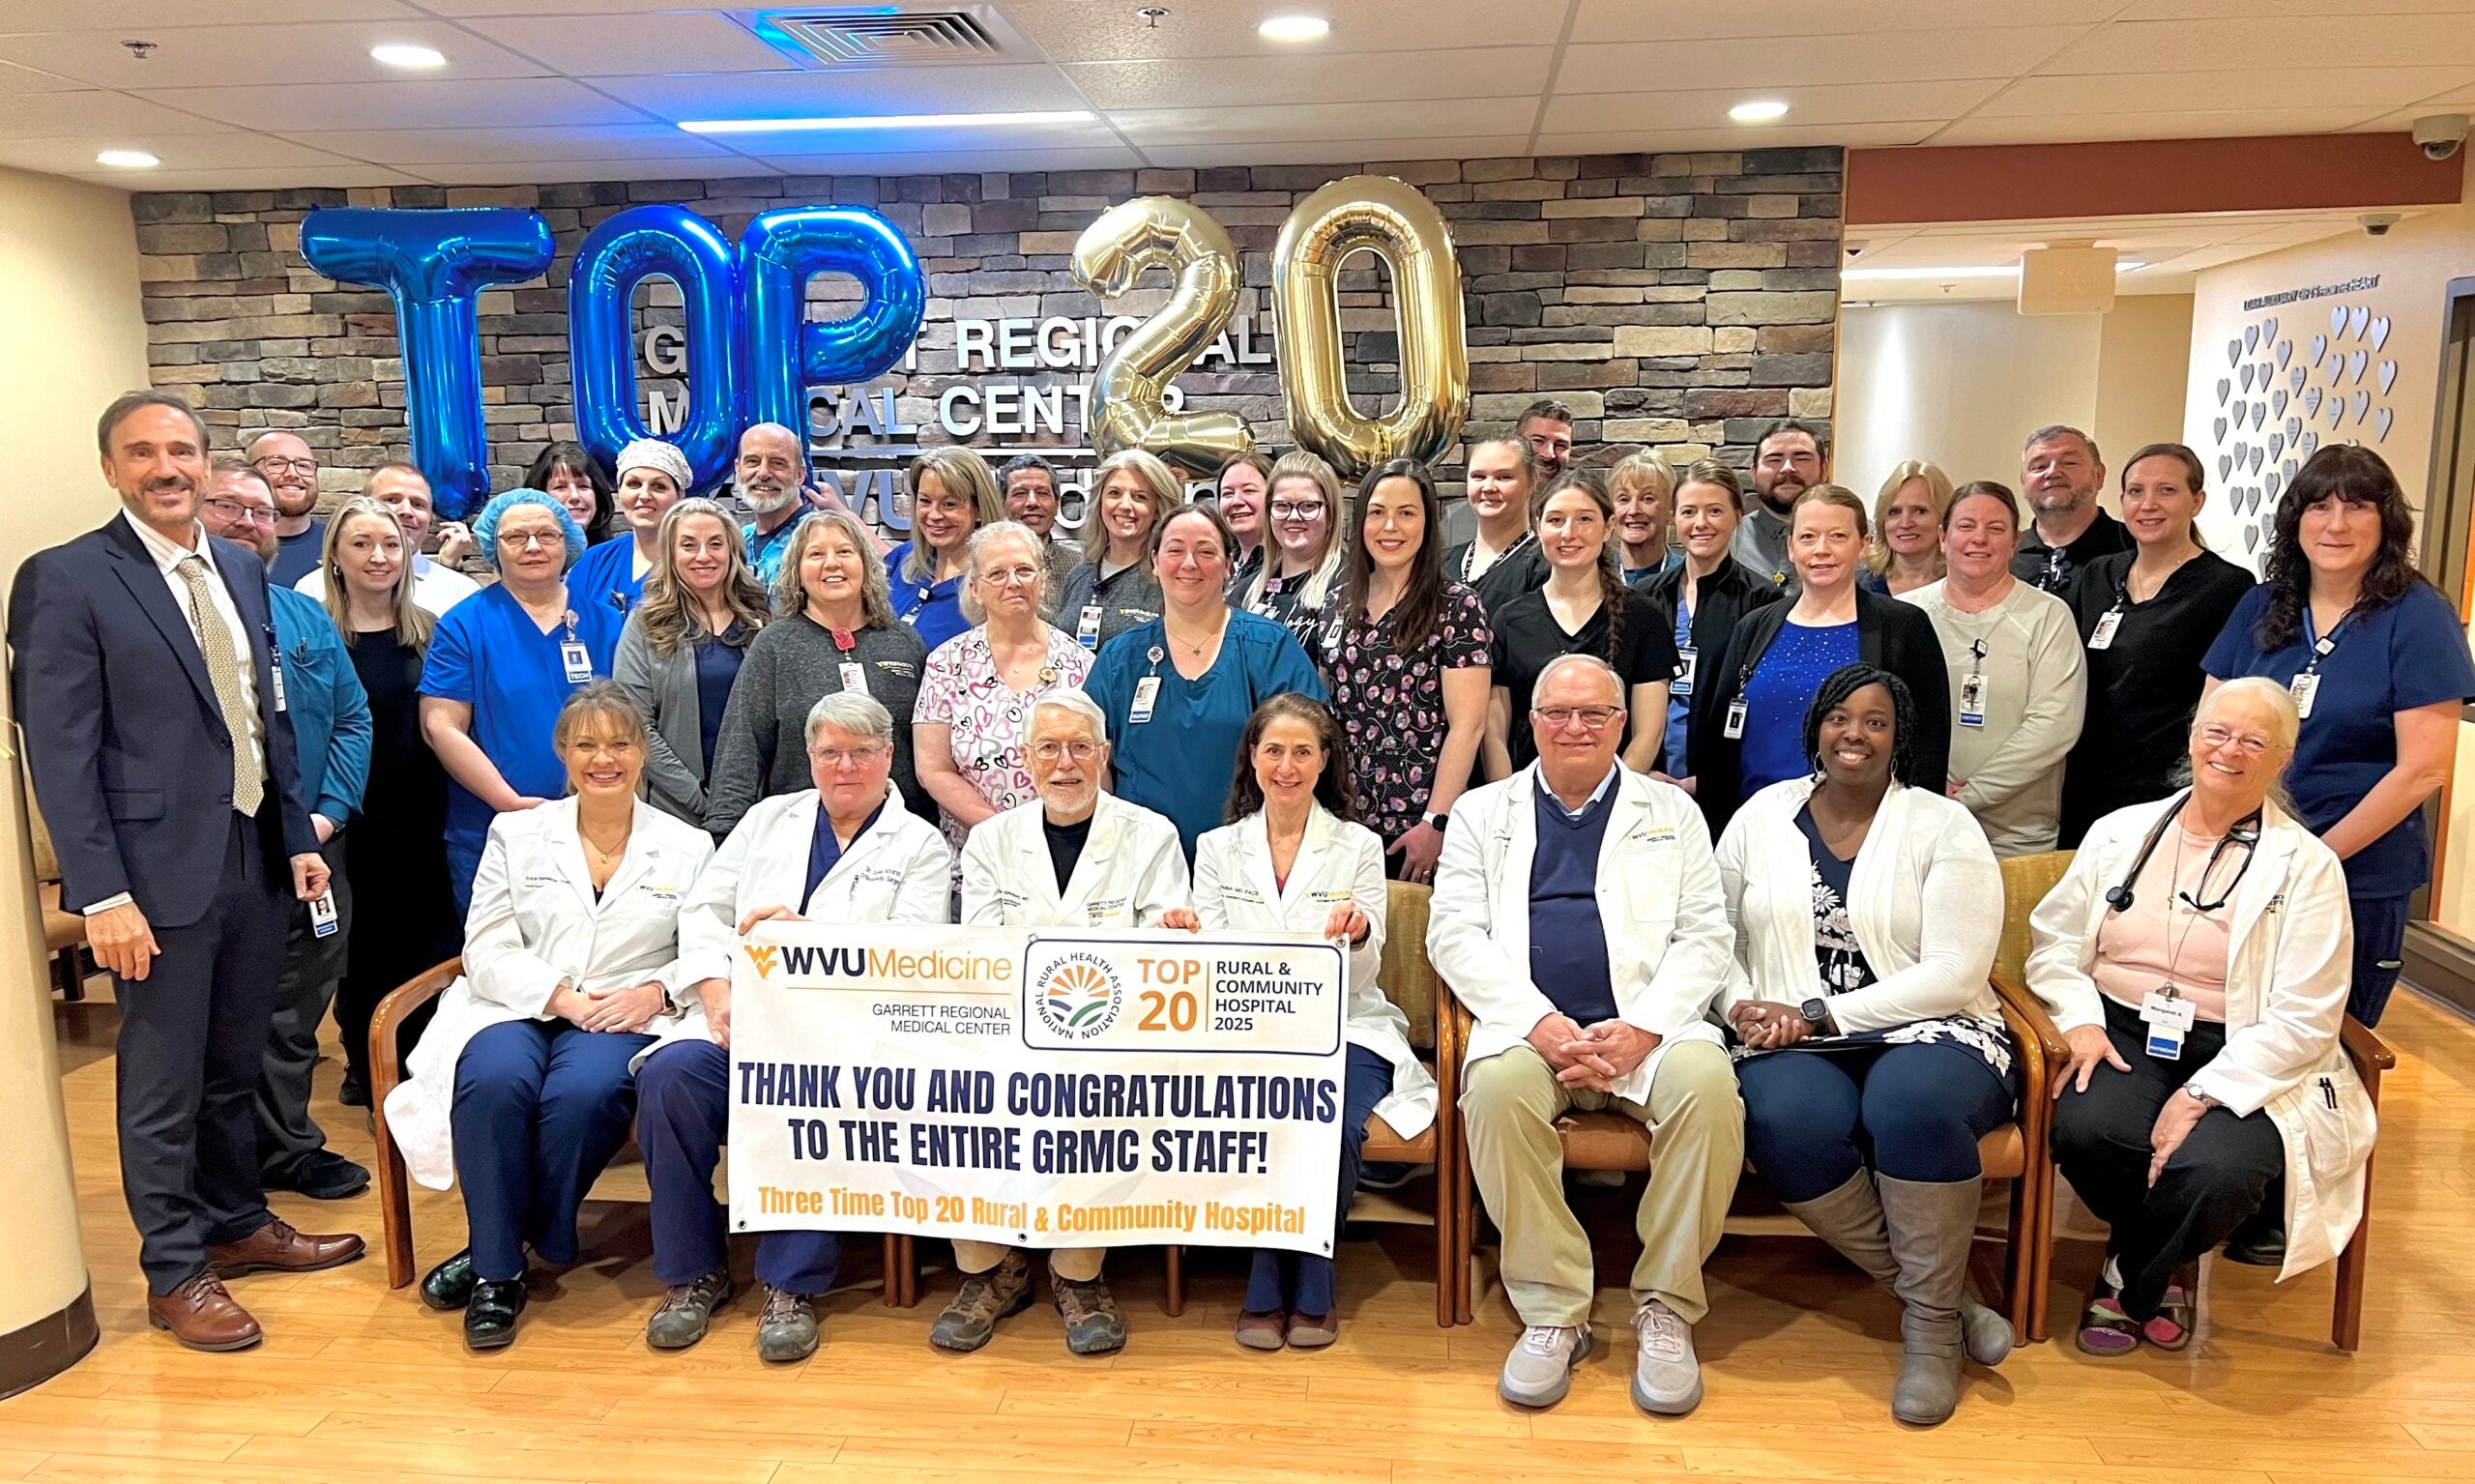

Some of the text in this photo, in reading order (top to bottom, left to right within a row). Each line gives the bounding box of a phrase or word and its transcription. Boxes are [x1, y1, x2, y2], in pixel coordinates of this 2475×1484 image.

[299, 175, 1470, 521] TOP 20
[955, 315, 1271, 368] REGIAL
[1037, 956, 1067, 988] RURAL
[1070, 952, 1113, 974] HEALTH
[1137, 959, 1202, 984] TOP
[1216, 961, 1292, 975] RURAL &
[1215, 979, 1324, 996] COMMUNITY
[872, 1004, 1011, 1020] GARRETT REGIONAL
[1035, 992, 1074, 1039] NATIONAL
[1081, 975, 1122, 1039] ASSOCIATION
[1137, 990, 1198, 1032] 20
[1215, 999, 1296, 1014] HOSPITAL
[890, 1020, 1010, 1035] MEDICAL CENTER
[1214, 1017, 1253, 1031] 2025
[738, 1062, 1338, 1123] THANK YOU AND CONGRATULATIONS
[788, 1118, 1268, 1174] TO THE ENTIRE GRMC STAFF!
[758, 1186, 1305, 1236] Three Time Top 20 Rural & Community Hospital
